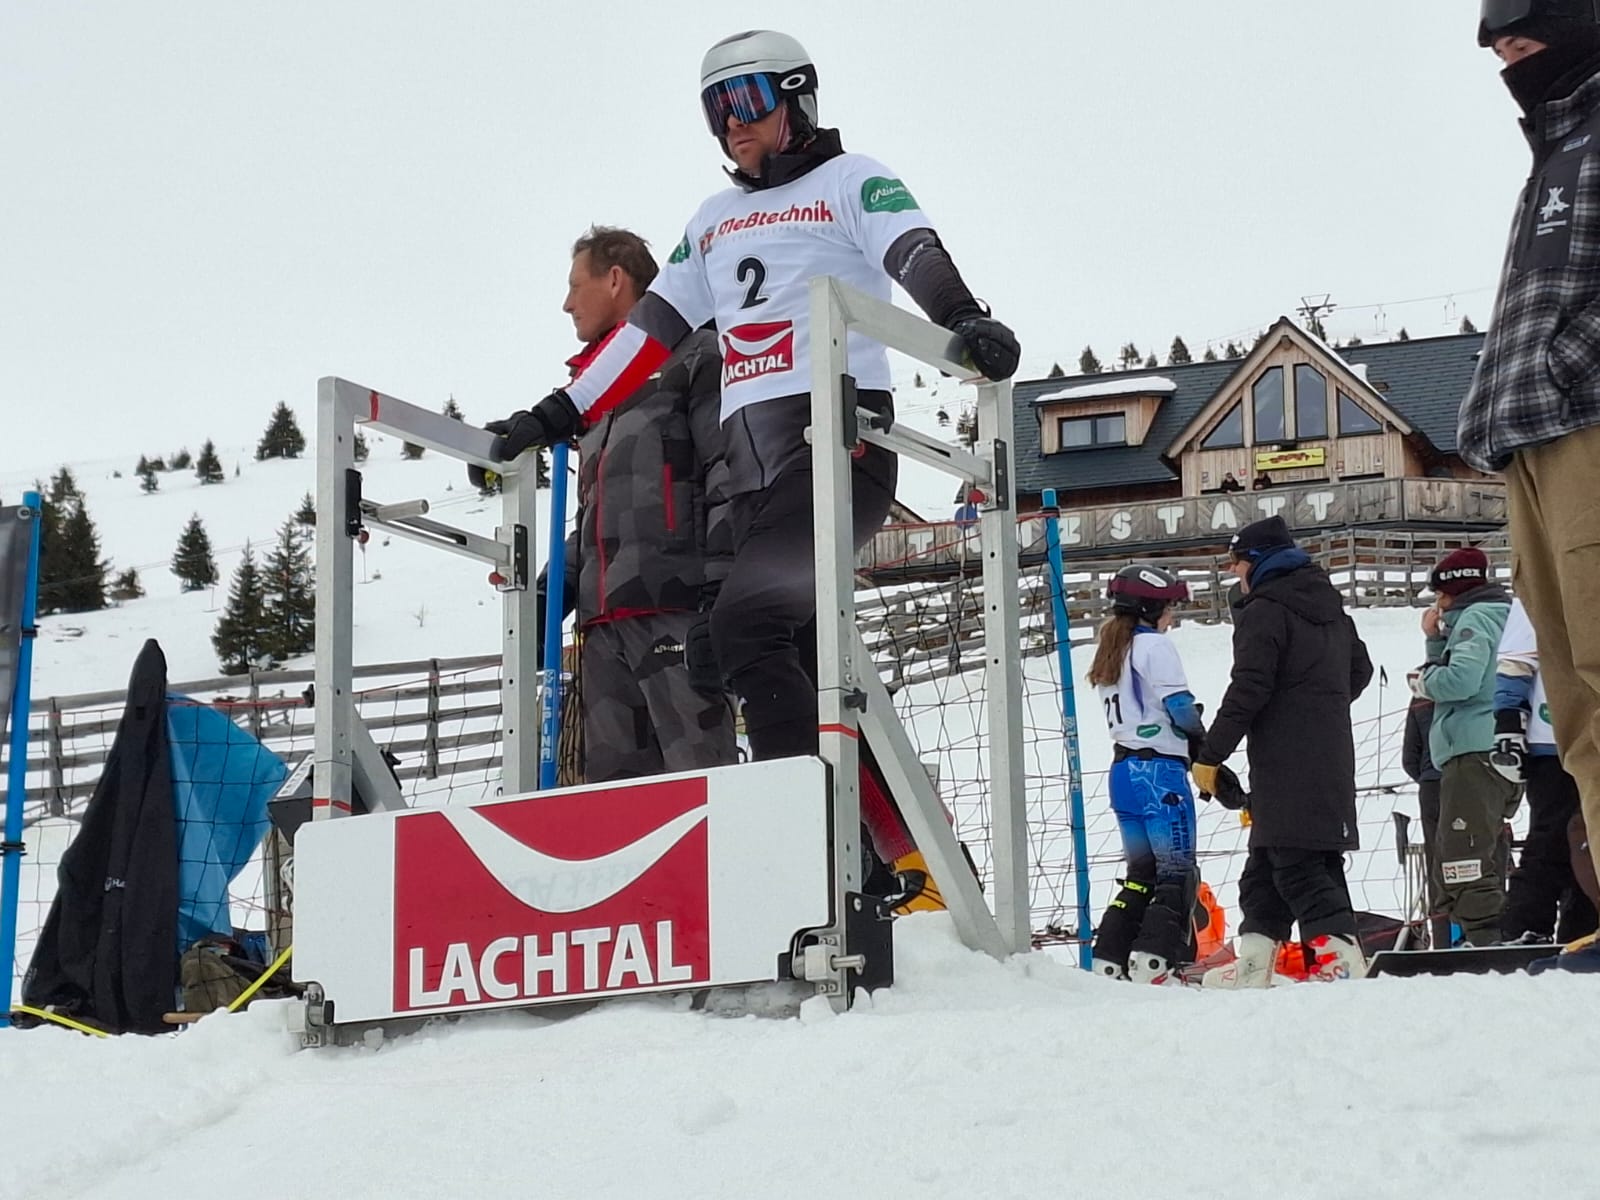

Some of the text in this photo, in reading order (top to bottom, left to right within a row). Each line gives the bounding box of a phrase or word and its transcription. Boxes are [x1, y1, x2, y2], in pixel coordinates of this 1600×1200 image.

[737, 256, 769, 309] 2
[1104, 693, 1123, 729] 21
[409, 920, 692, 1007] LACHTAL
